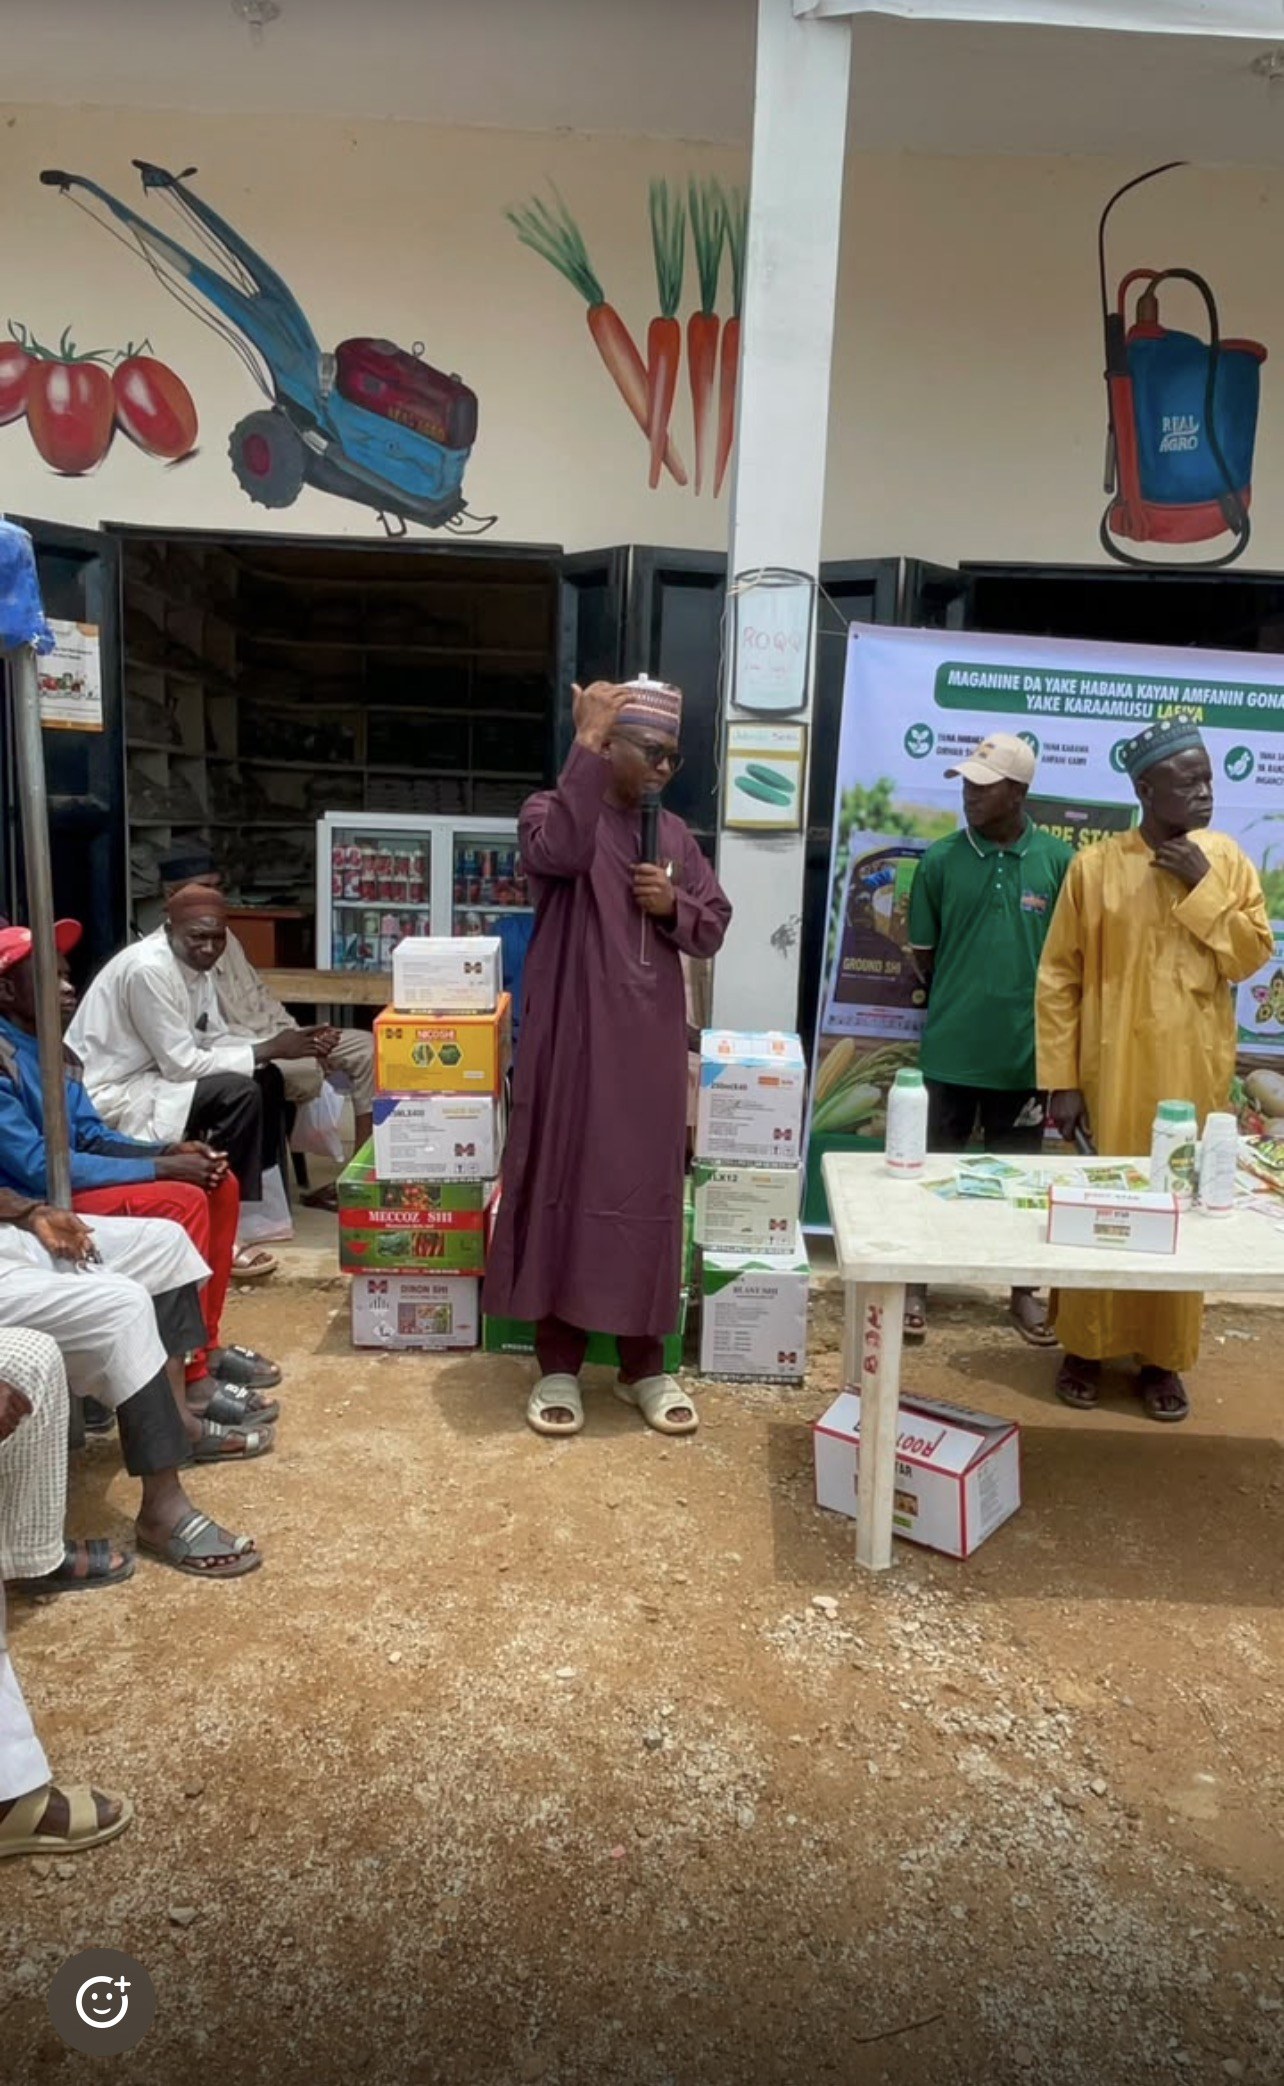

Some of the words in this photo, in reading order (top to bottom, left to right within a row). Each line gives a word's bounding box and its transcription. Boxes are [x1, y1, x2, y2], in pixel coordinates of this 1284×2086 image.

[1162, 415, 1199, 434] REAL
[1159, 435, 1199, 452] AGRO
[947, 669, 1020, 690] MAGANINE
[1023, 676, 1042, 692] DA
[1045, 677, 1077, 694] YAKE
[1080, 679, 1133, 699] HABAKA
[1136, 683, 1179, 702] KAYAN
[1181, 686, 1244, 706] AMFANIN
[1025, 693, 1060, 711] YAKE
[1064, 696, 1153, 718] KARAAMUSU
